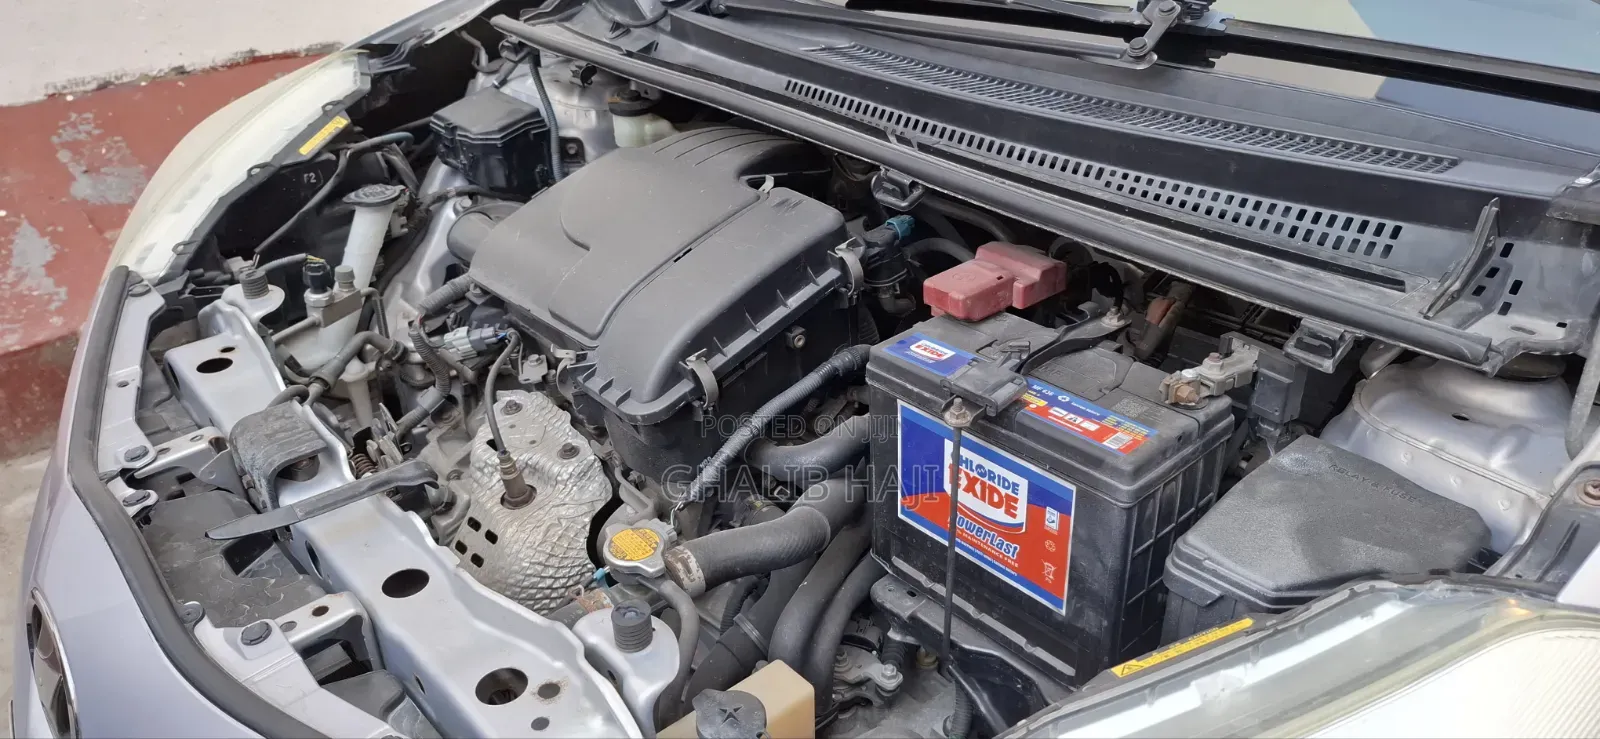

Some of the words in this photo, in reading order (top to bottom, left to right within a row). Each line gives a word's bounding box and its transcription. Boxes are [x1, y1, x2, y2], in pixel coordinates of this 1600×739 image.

[949, 463, 1019, 520] EXIDE
[958, 454, 1020, 496] HLORIDE
[1328, 464, 1370, 482] RELAY
[947, 512, 1020, 559] owerLast
